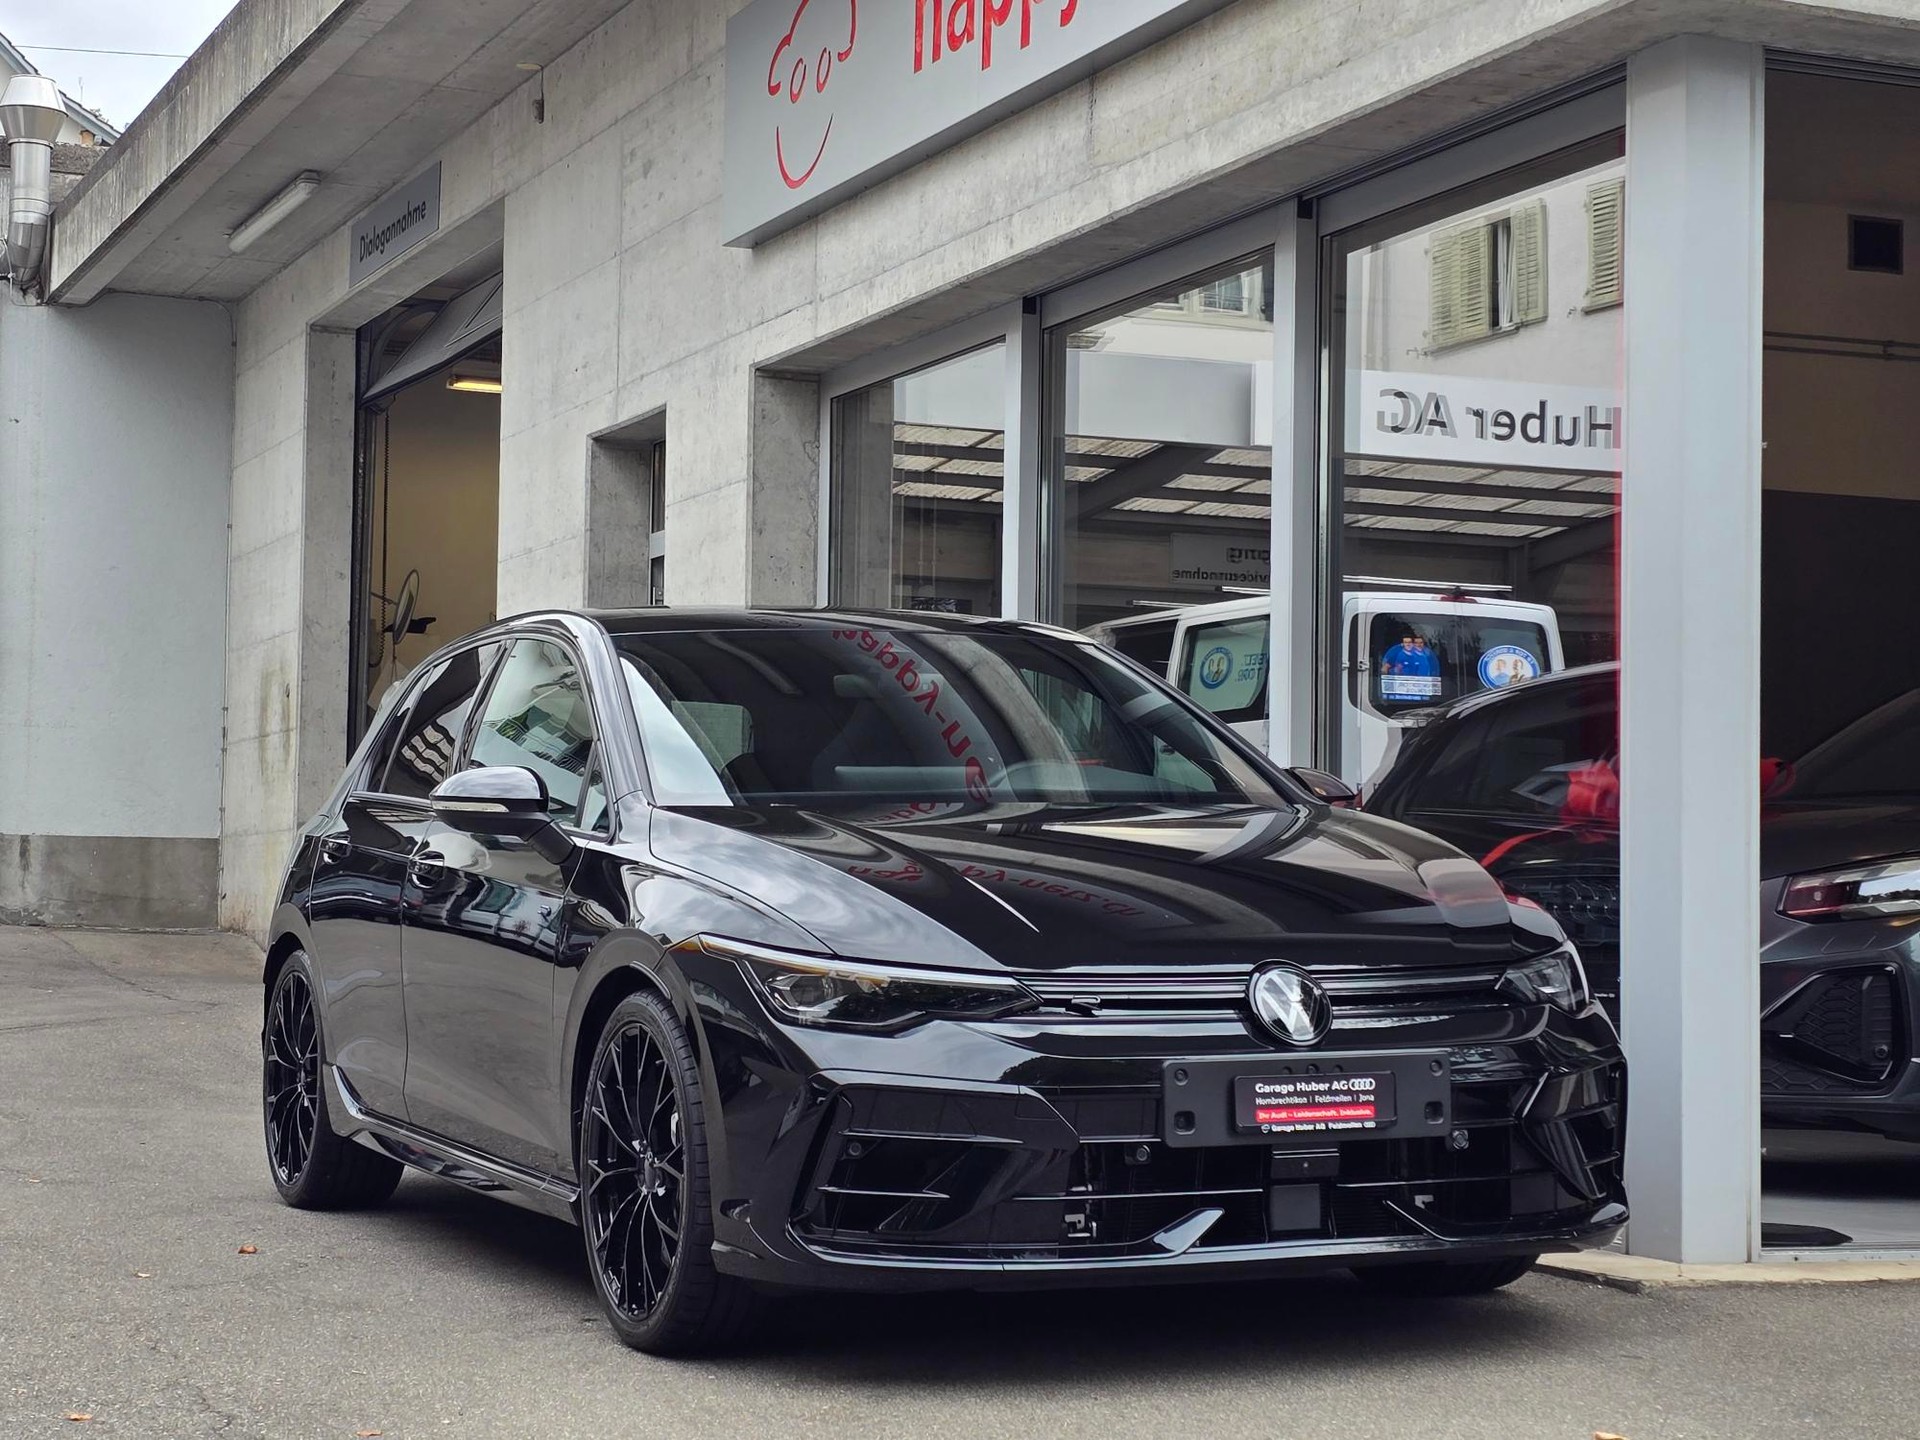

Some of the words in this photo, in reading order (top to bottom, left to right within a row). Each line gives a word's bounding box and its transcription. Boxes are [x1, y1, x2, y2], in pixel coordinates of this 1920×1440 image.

[913, 0, 1077, 74] hap
[359, 200, 427, 263] Dialogannahme
[1255, 1083, 1295, 1094] Garage
[1296, 1081, 1330, 1091] Huber
[1331, 1080, 1349, 1090] AG
[1358, 1093, 1375, 1102] Jona
